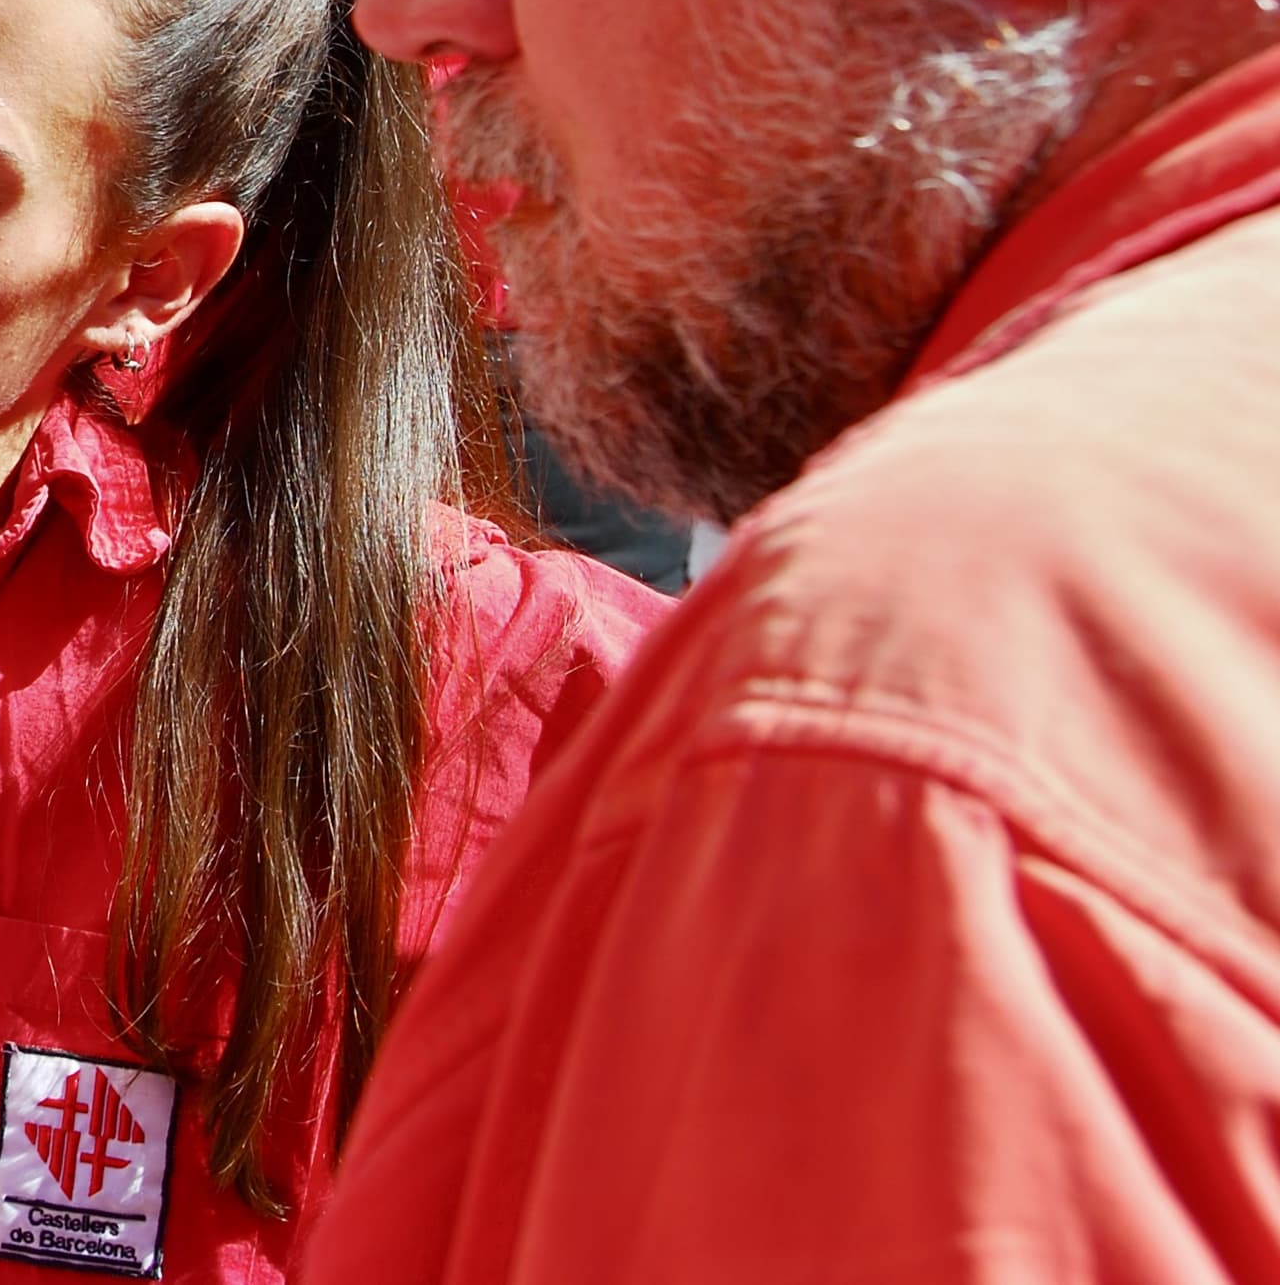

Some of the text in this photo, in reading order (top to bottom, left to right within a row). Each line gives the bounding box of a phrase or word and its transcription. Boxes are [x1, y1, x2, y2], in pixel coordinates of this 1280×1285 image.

[28, 1207, 120, 1235] Castellers
[9, 1228, 137, 1260] de Barcelona
